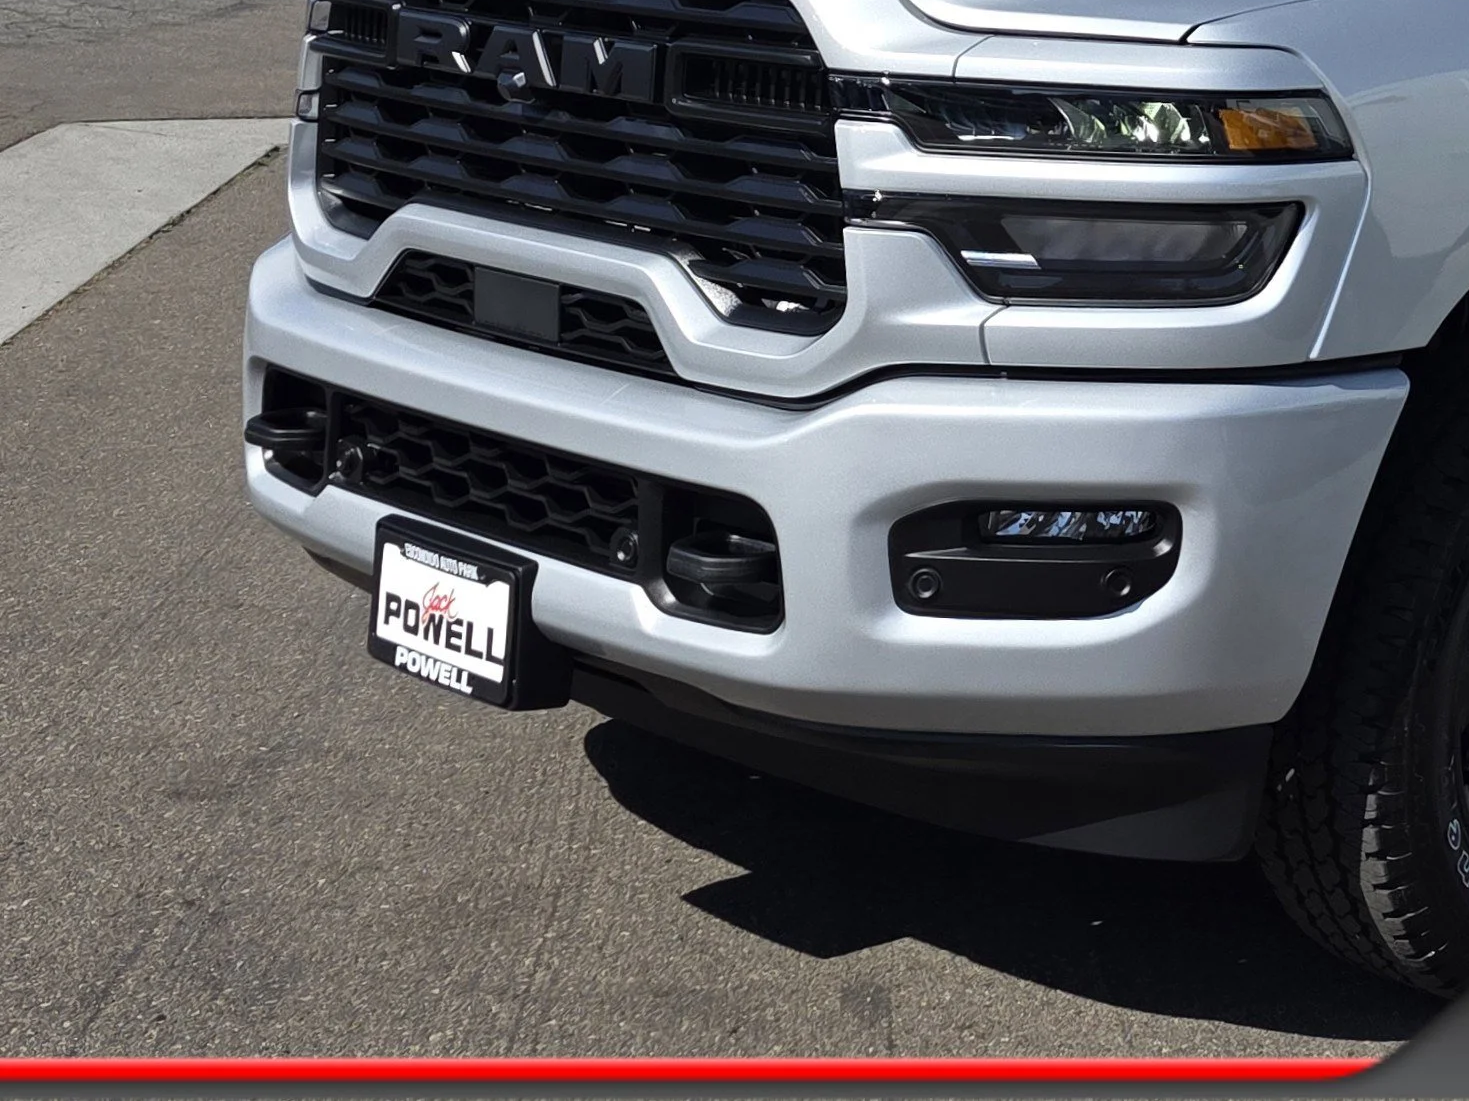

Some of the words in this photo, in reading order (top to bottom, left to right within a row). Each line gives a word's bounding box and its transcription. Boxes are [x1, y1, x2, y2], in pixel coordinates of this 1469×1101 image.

[395, 7, 657, 104] RAM
[439, 555, 459, 576] AUTO
[458, 561, 480, 581] PARK
[384, 591, 505, 664] POWELL
[421, 581, 459, 625] Jack
[394, 645, 474, 695] POWELL
